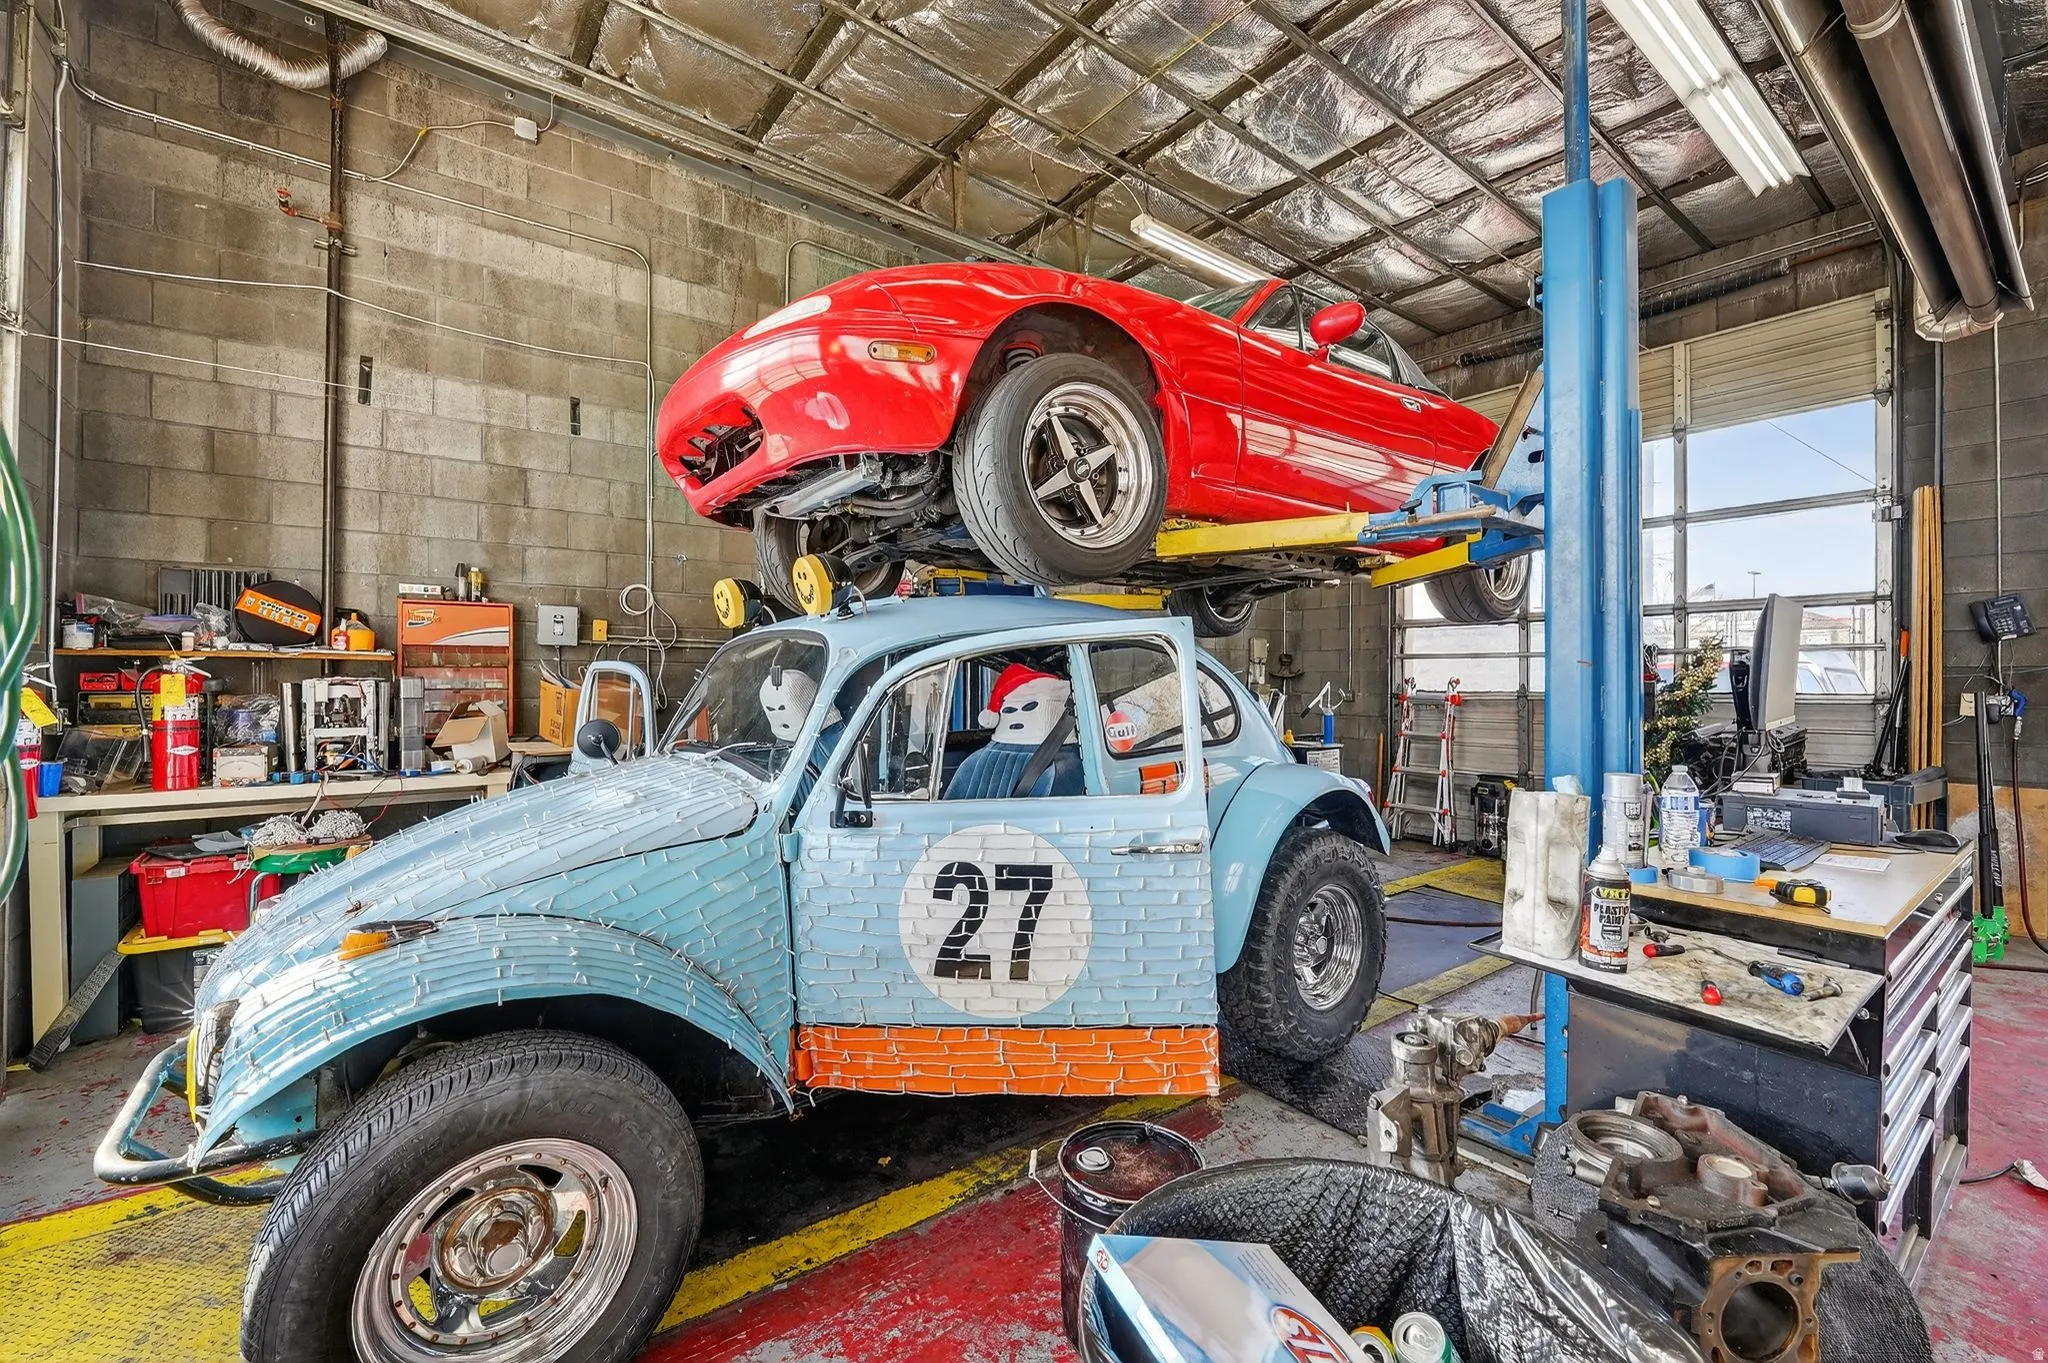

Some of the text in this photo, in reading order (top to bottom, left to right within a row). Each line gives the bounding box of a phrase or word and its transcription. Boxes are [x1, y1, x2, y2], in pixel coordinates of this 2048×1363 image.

[1107, 724, 1136, 738] Gulf
[1593, 903, 1629, 916] PLASTIC
[932, 861, 1054, 981] 27
[1599, 914, 1625, 926] PAINT
